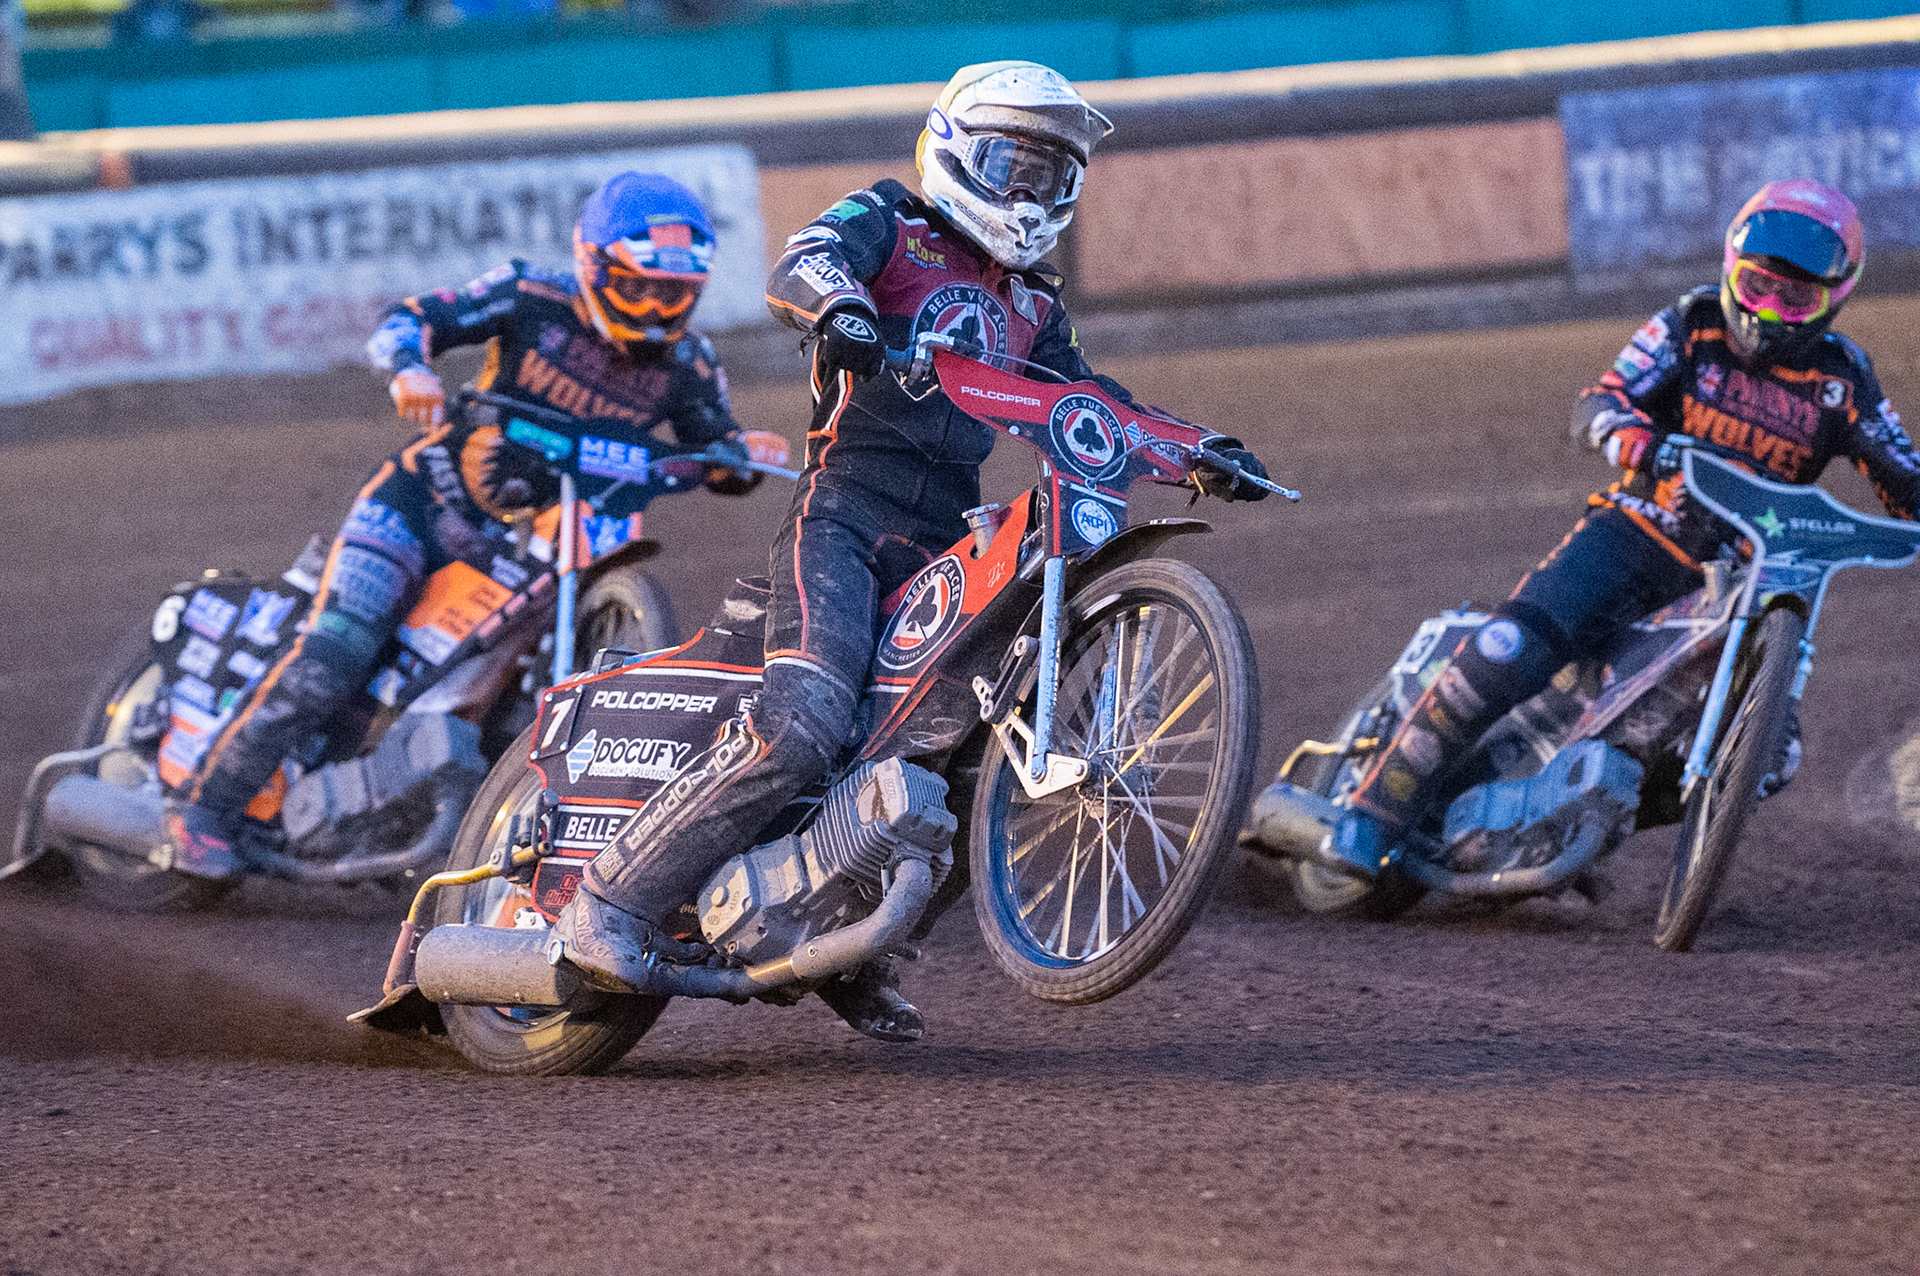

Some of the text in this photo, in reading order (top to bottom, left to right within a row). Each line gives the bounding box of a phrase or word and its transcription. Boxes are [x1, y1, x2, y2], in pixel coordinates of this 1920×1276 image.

[927, 289, 961, 315] BELLE
[967, 290, 992, 311] VUE
[961, 385, 1041, 407] POLCOPPER
[1821, 380, 1845, 407] 3
[1055, 399, 1079, 421] BELLE
[1081, 399, 1102, 412] VUE
[1682, 395, 1812, 482] WOLVES
[591, 690, 718, 713] POLCOPPER
[539, 697, 575, 749] 1
[595, 737, 689, 769] DOCUFY
[590, 765, 628, 778] DOCUMENT
[623, 732, 748, 851] POLCOPPER
[564, 816, 622, 841] BELLE
